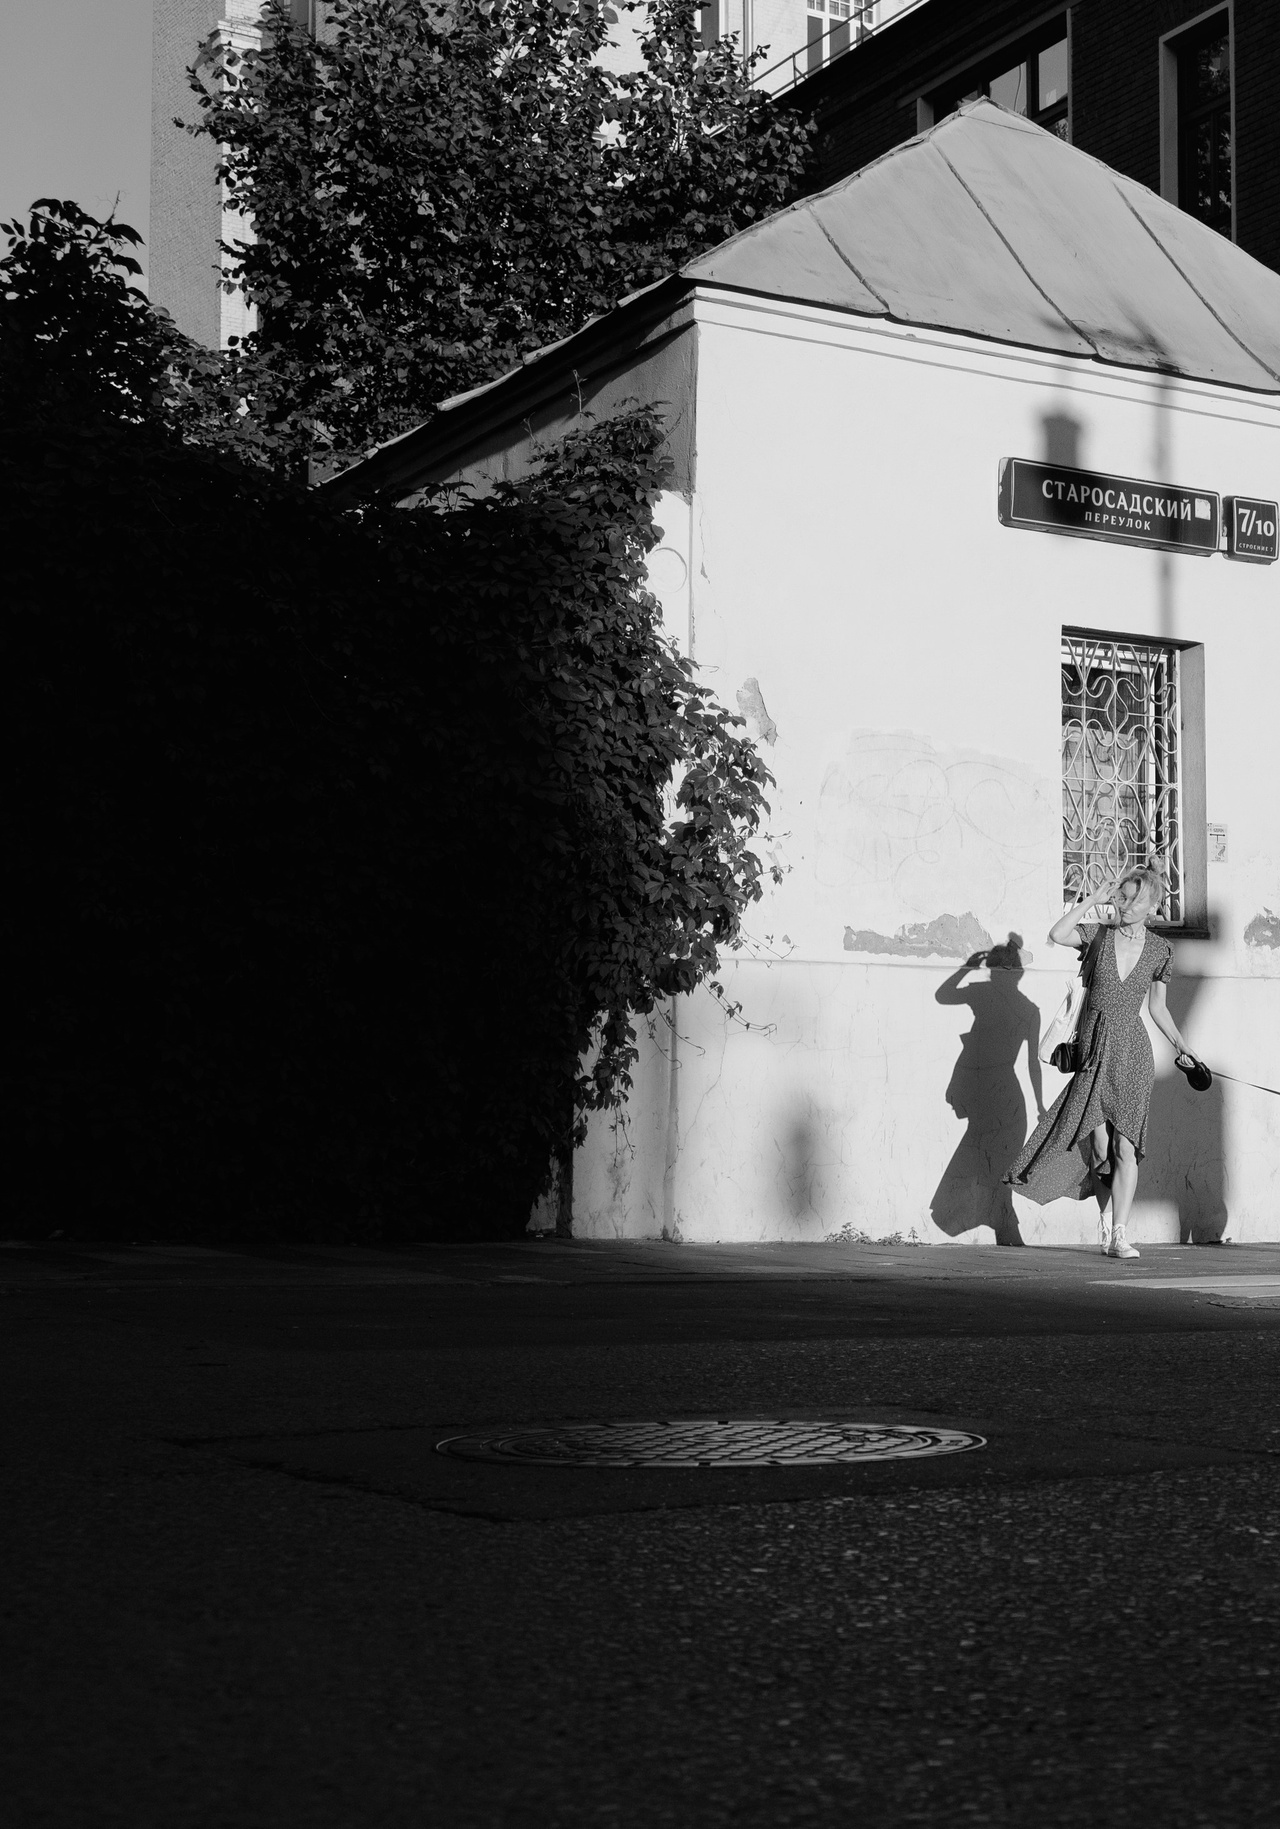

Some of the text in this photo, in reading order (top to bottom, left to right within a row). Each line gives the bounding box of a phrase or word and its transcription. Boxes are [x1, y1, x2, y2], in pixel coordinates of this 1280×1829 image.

[1041, 479, 1192, 521] СТАРОСАДСКИЙ
[1084, 511, 1151, 531] ПЕРЕУЛОК
[1238, 508, 1275, 537] 7/10
